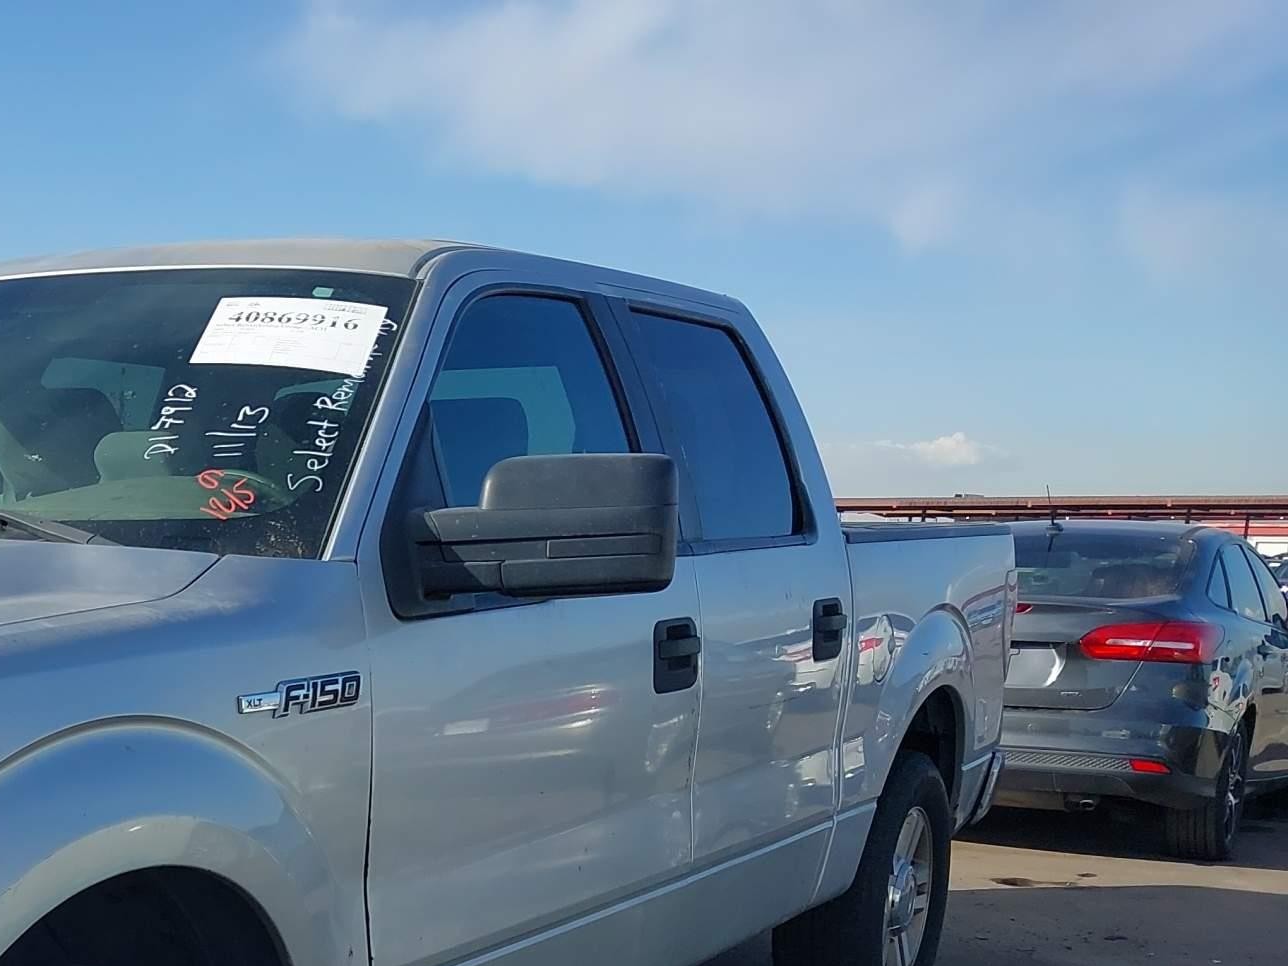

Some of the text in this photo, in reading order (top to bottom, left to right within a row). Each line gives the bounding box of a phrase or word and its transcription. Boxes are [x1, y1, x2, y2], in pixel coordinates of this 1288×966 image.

[228, 311, 362, 331] 40869916
[287, 419, 340, 492] Select
[246, 674, 361, 715] XLT F-150
